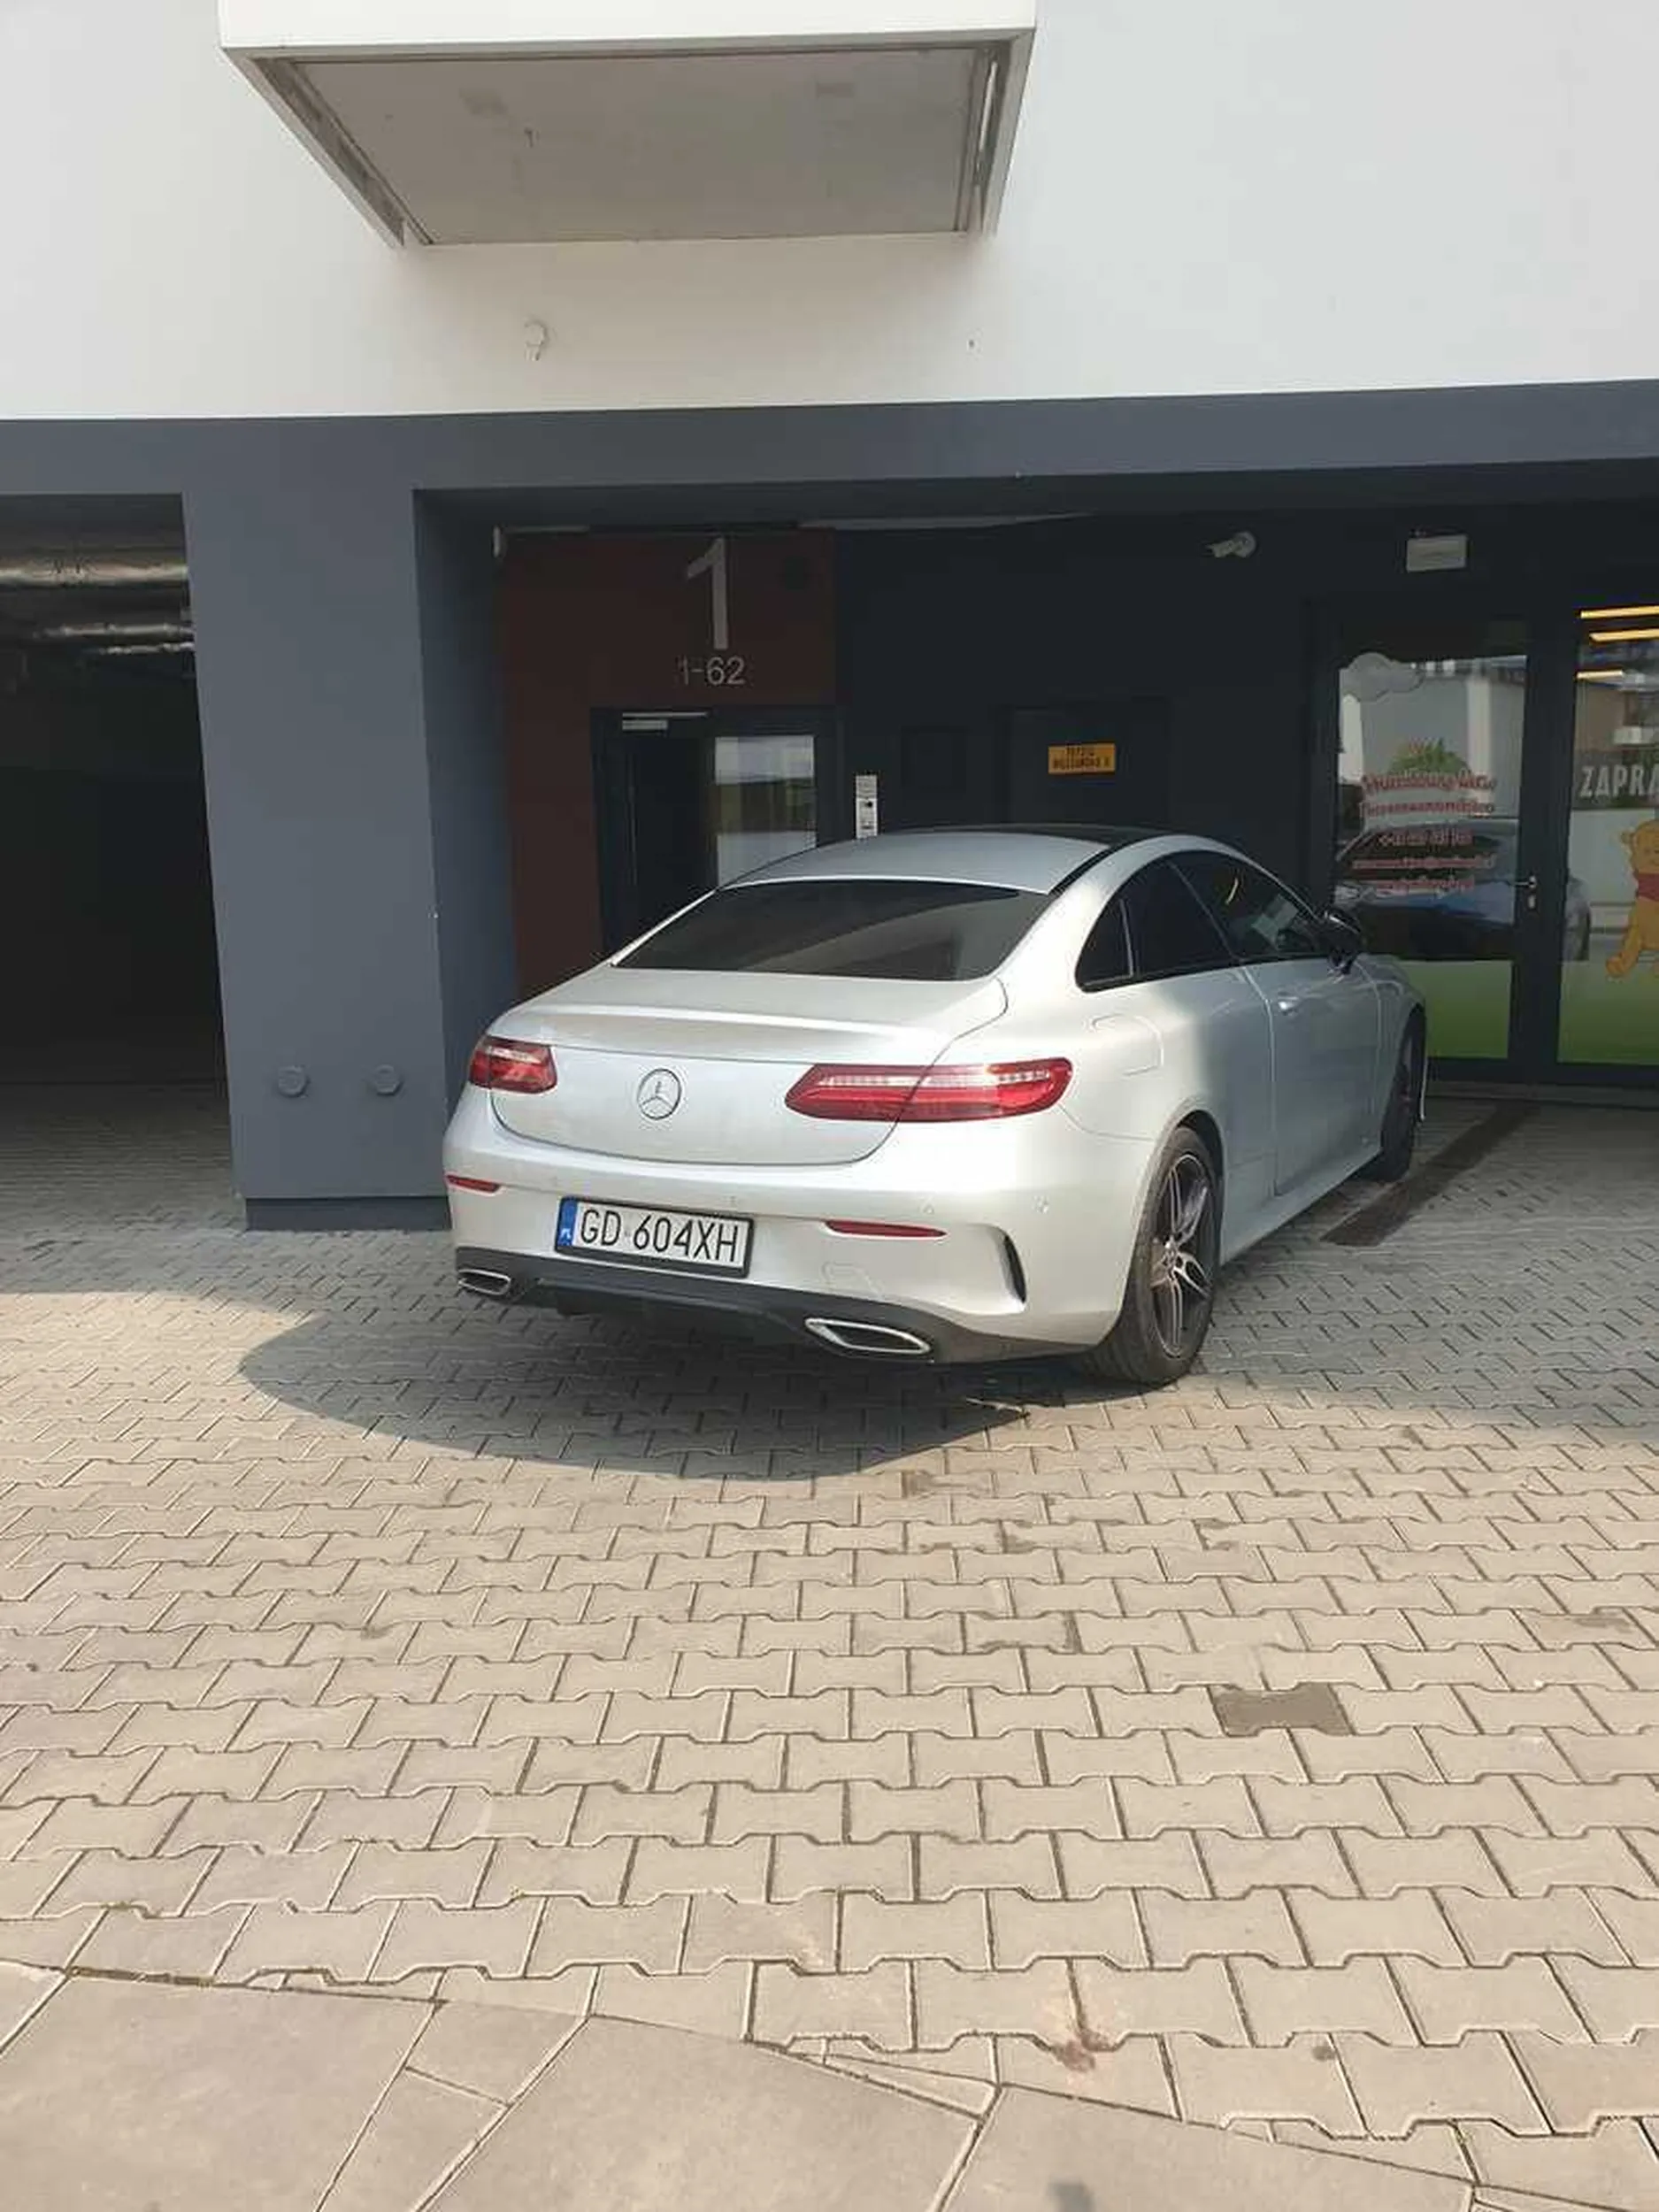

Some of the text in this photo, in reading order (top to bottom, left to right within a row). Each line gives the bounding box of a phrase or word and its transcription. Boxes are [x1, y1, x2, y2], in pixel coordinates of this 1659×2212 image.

[687, 536, 729, 650] 1
[677, 654, 746, 686] 1-62
[580, 1209, 739, 1263] GD 604XH
